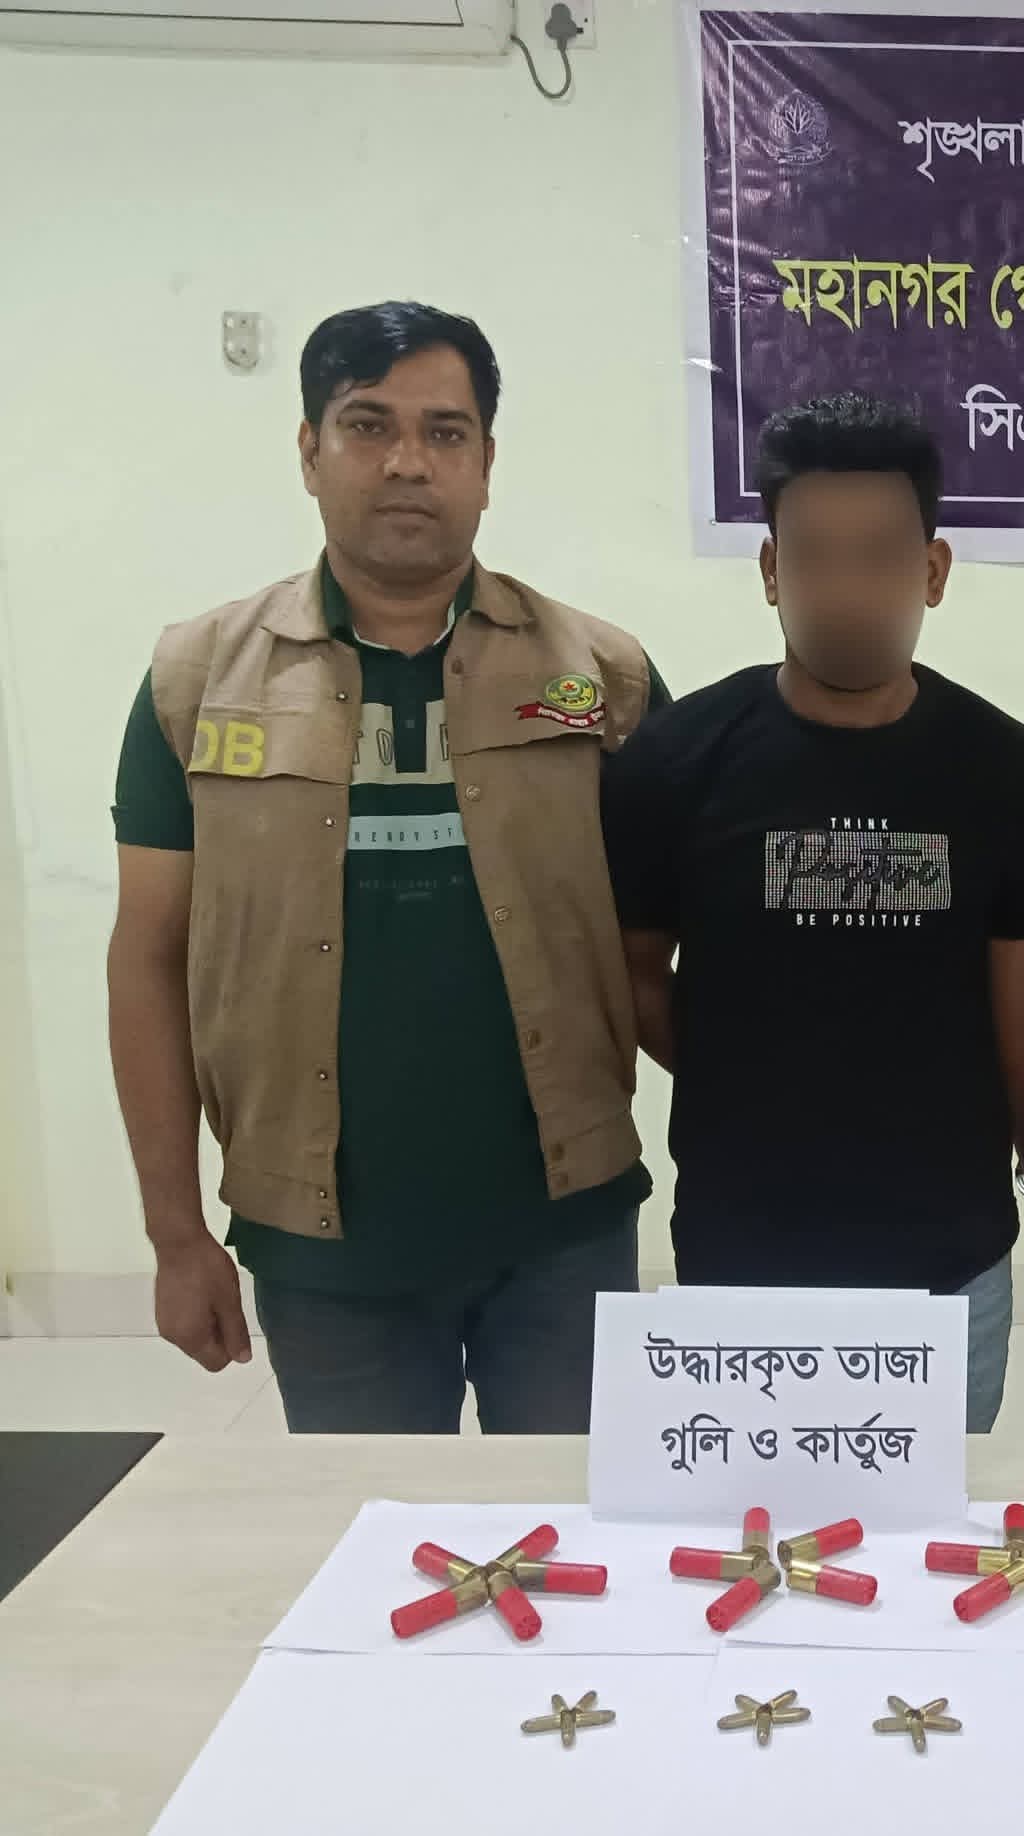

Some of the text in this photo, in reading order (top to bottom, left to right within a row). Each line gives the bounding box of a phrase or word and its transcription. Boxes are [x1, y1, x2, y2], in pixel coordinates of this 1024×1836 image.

[772, 253, 975, 334] মহানগর
[830, 817, 888, 830] THINK
[796, 913, 921, 927] BE POSITIVE
[644, 1331, 936, 1401] উদ্ধারকৃত তাজা
[661, 1412, 918, 1474] গুলি ও কার্তুজ
